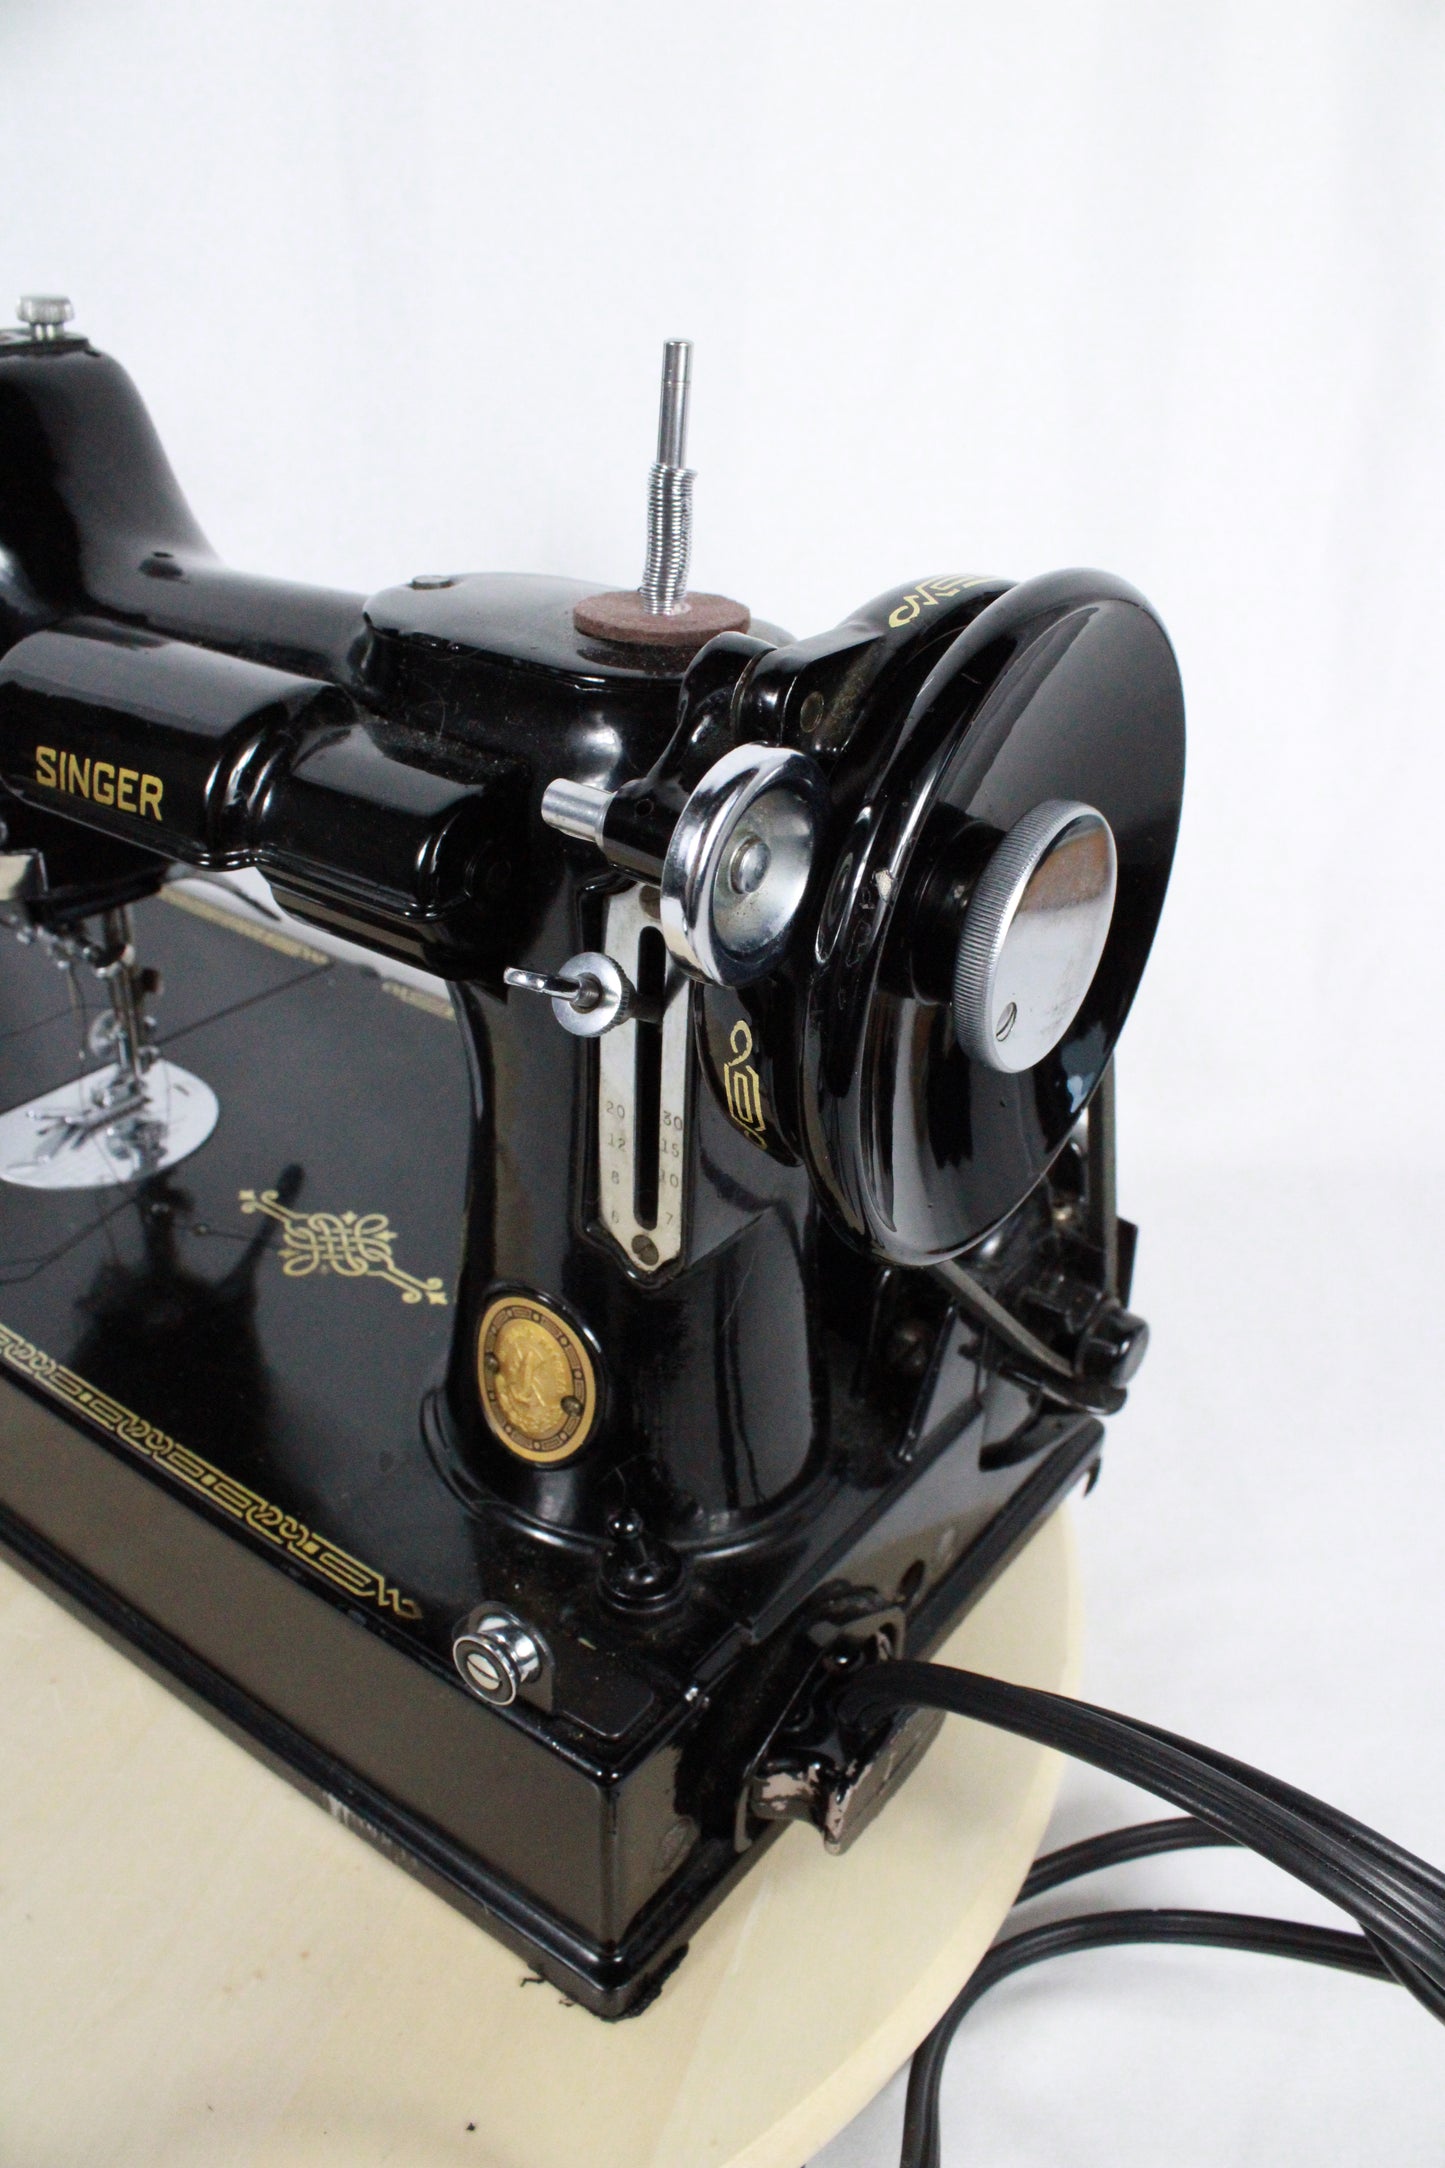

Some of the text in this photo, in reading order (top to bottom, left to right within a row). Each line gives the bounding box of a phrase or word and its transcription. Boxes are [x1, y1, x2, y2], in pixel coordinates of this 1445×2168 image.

[35, 745, 163, 822] SINGER
[606, 1100, 625, 1120] 20
[663, 1110, 683, 1131] 30
[607, 1132, 626, 1152] 12
[661, 1137, 680, 1158] 15
[659, 1168, 680, 1189] 10
[665, 1211, 674, 1225] 7
